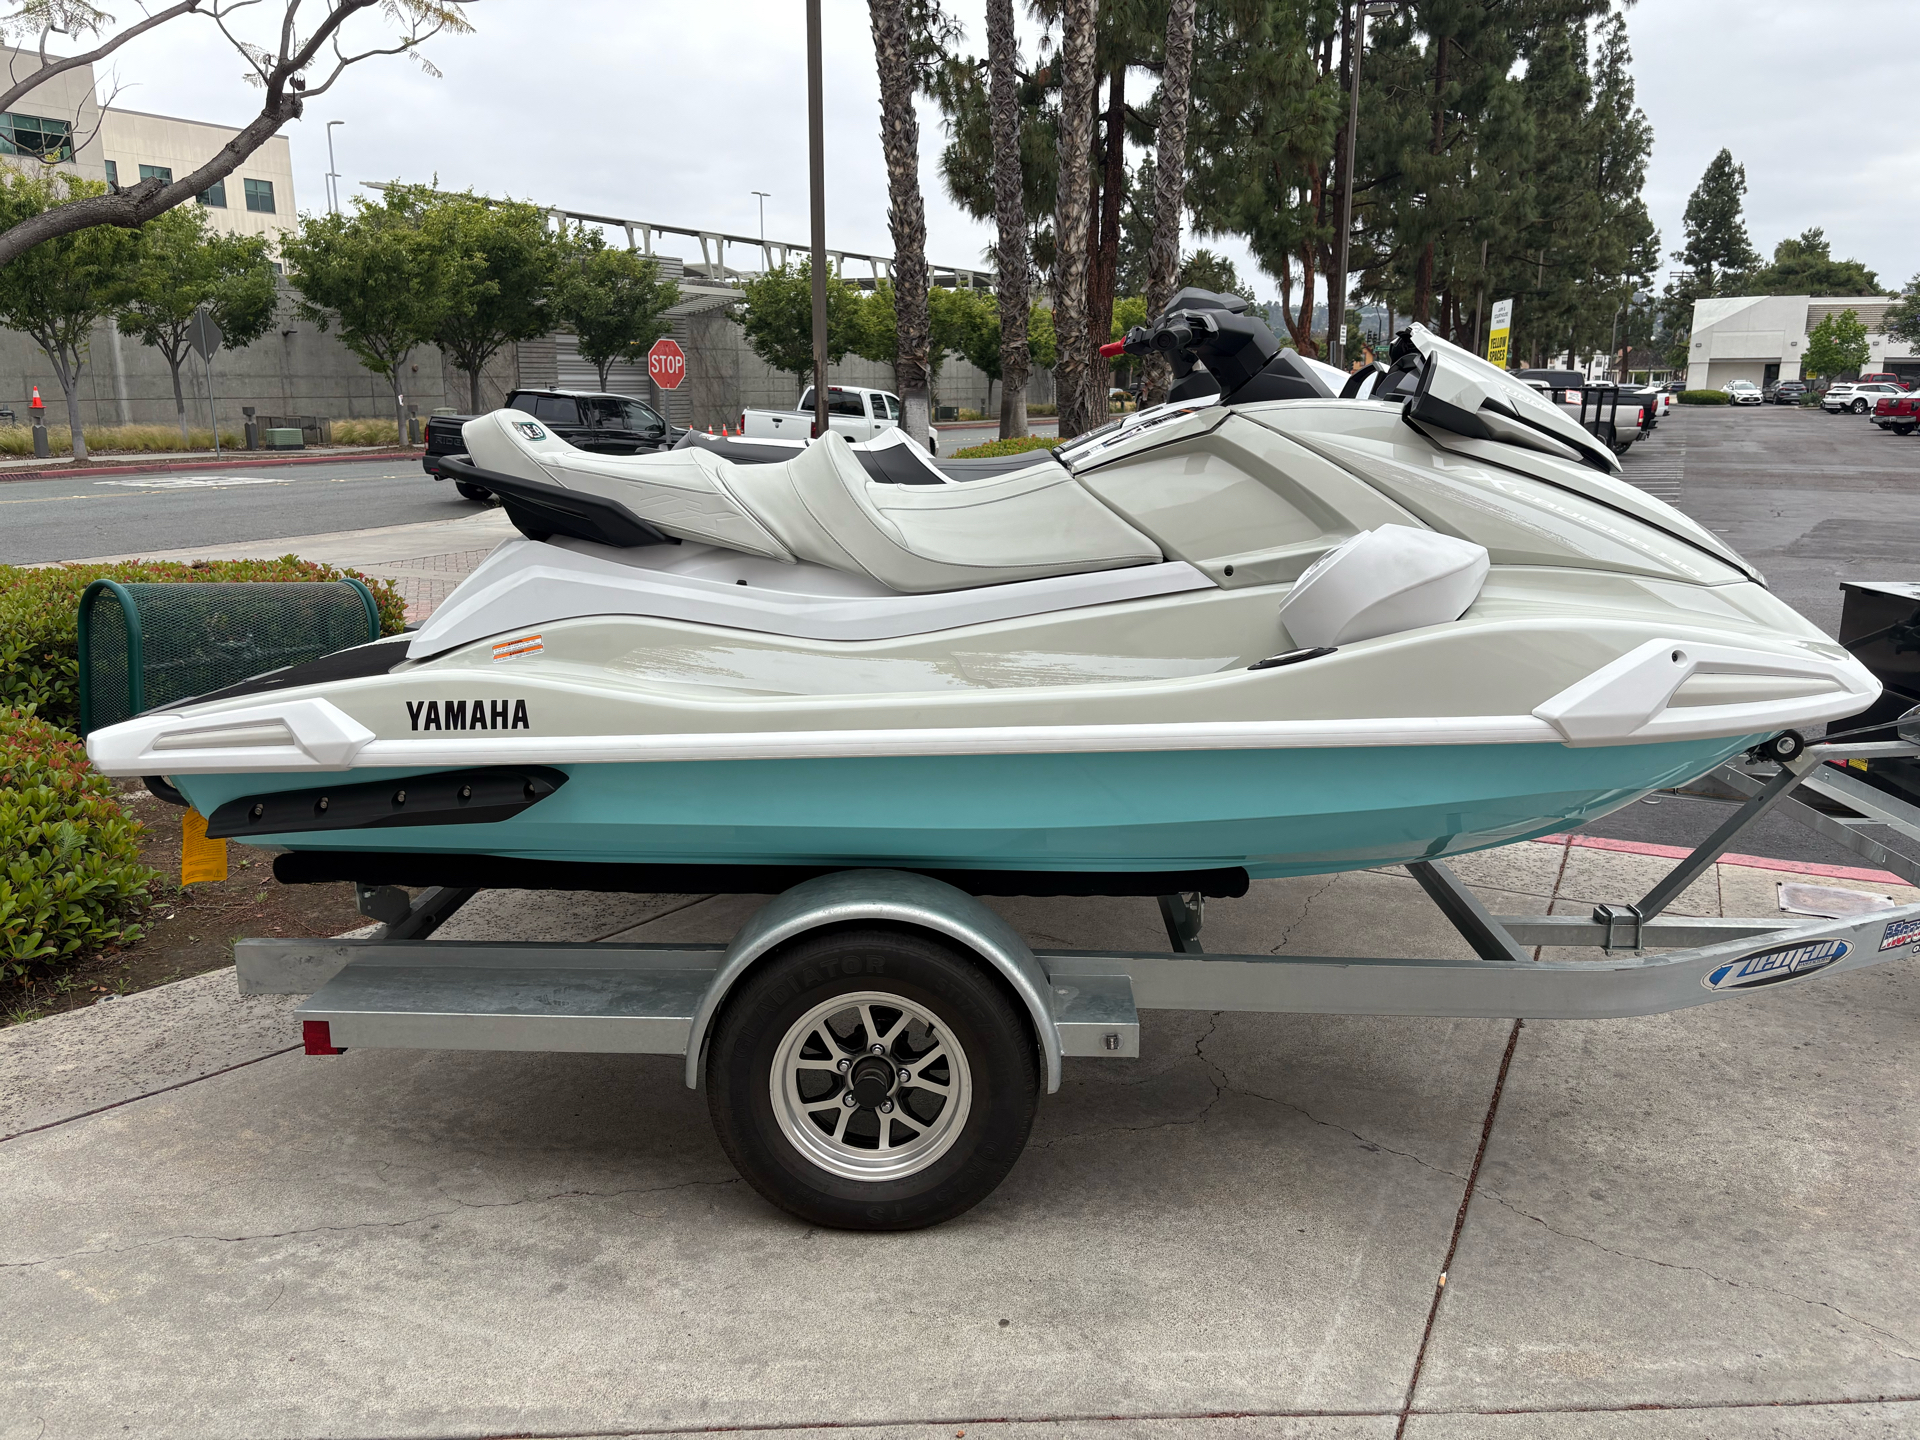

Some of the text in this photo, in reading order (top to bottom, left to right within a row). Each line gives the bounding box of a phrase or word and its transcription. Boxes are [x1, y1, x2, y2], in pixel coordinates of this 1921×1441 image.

[1489, 349, 1505, 362] SPACES
[1491, 336, 1507, 349] YELLOW
[651, 354, 683, 374] STOP
[1512, 489, 1652, 551] CRUISER
[405, 699, 530, 731] YAMAHA
[733, 954, 886, 1059] GLADIATOR
